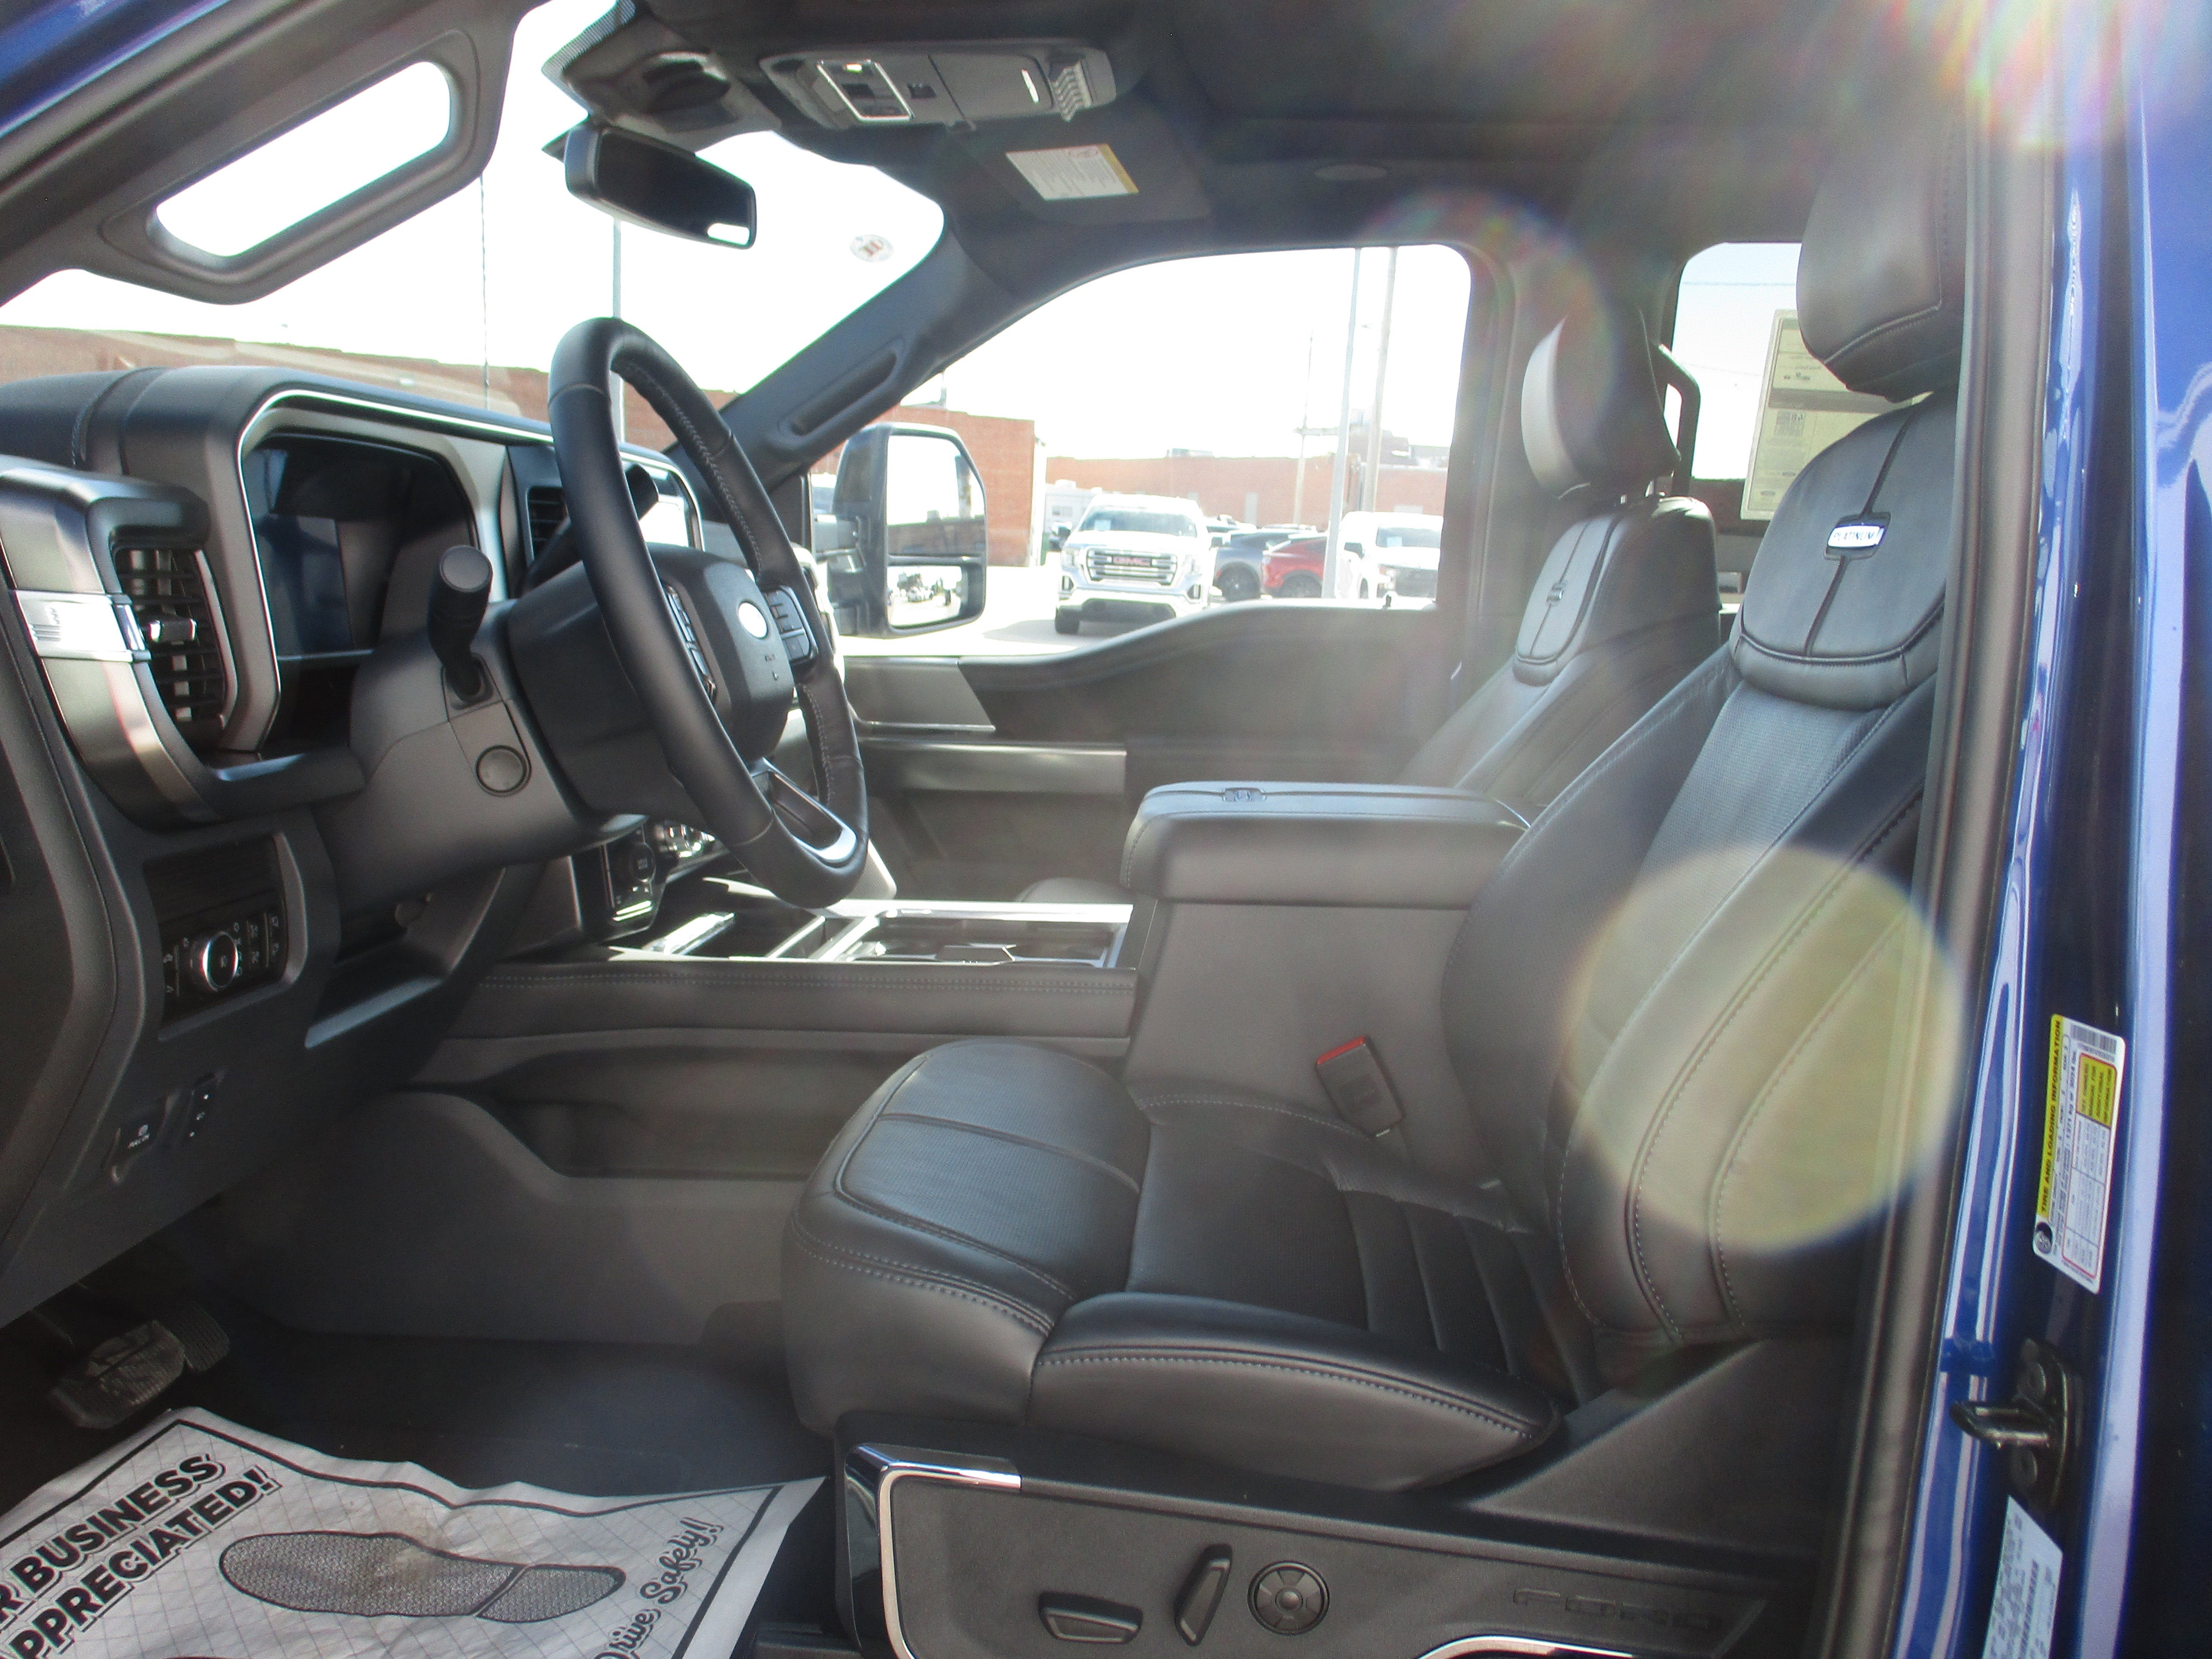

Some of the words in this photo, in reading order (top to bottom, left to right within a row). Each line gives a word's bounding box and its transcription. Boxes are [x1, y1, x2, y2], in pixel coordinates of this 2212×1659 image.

[1833, 532, 1875, 541] PLATINUM
[2046, 1104, 2055, 1156] LOADING
[2051, 1020, 2060, 1101] INFORMATION
[10, 1455, 219, 1594] BUSINESS
[594, 1612, 655, 1659] rive
